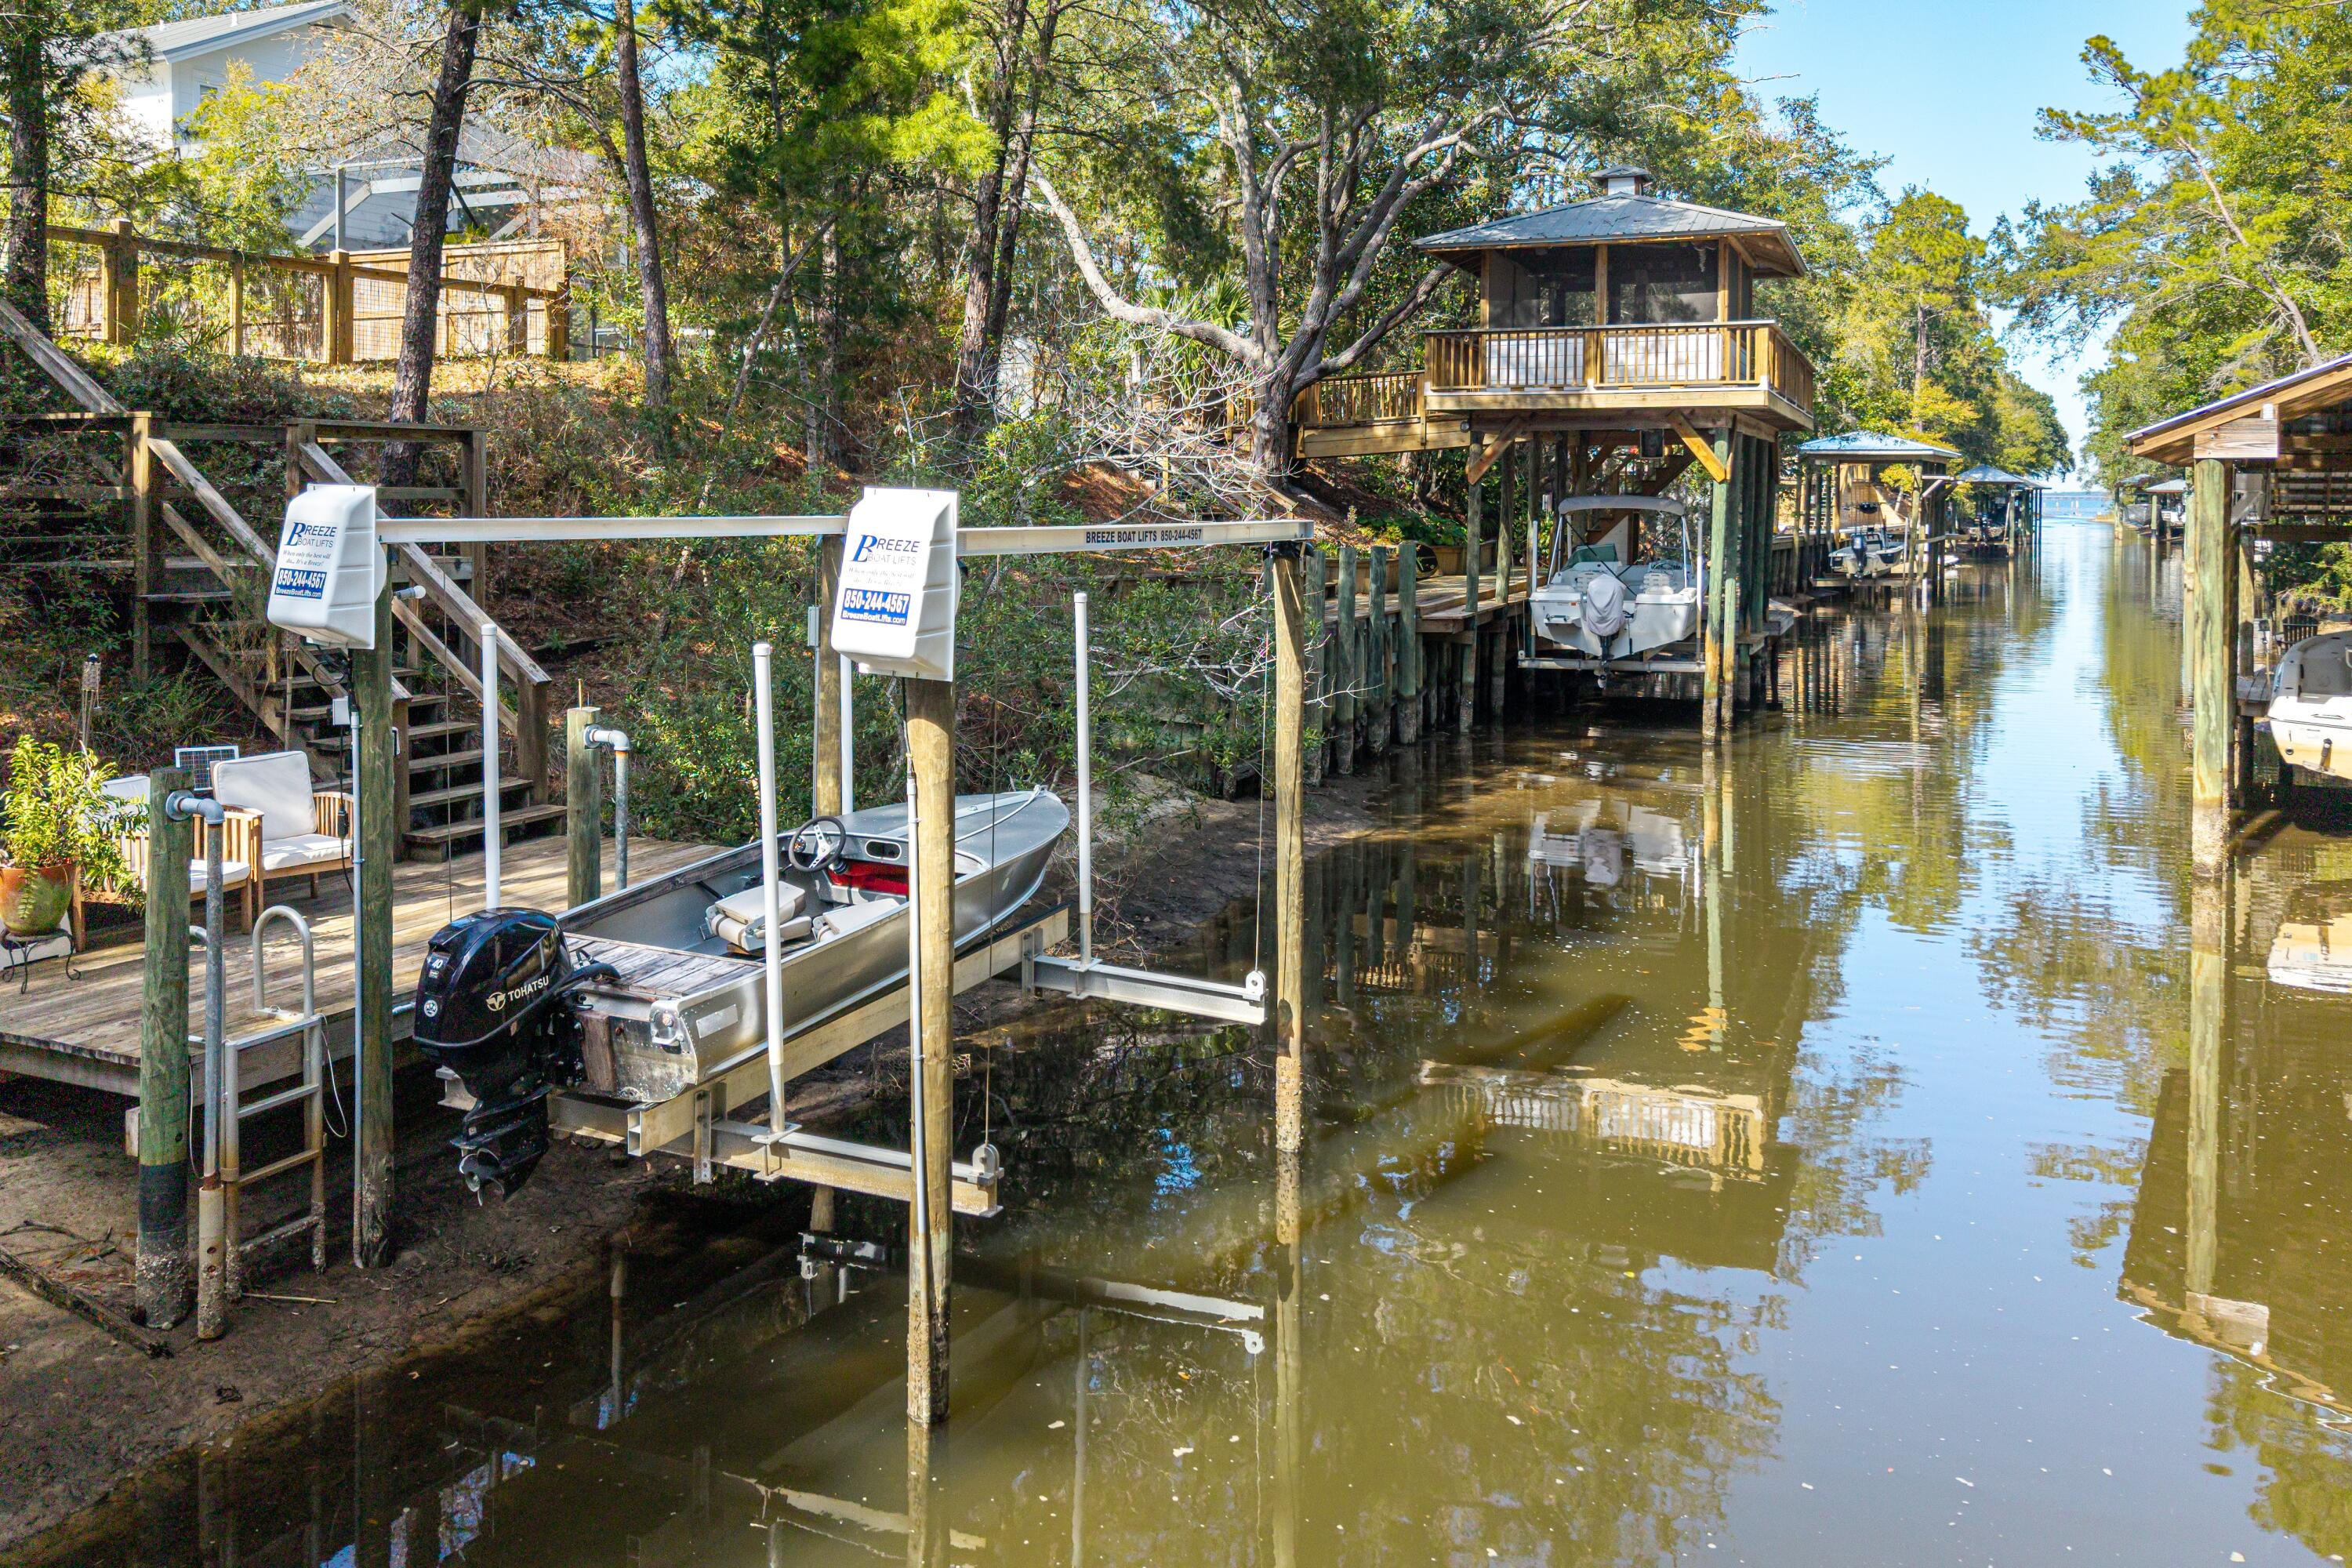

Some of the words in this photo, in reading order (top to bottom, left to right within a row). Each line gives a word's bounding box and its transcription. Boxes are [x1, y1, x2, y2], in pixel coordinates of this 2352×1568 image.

[285, 522, 337, 546] BREEZE
[1086, 531, 1115, 543] BREEZE
[1117, 531, 1136, 543] BOAT
[1138, 530, 1157, 543] LIFTS
[1160, 528, 1202, 542] 850-244-4567
[298, 538, 315, 546] BOAT
[315, 539, 334, 548] LIFTS
[849, 534, 920, 563] BREEZE
[867, 553, 891, 563] BOAT
[892, 554, 917, 566] LIFTS
[278, 569, 325, 589] 850-244-4567
[275, 586, 321, 597] BreezeBoatLifts.com
[844, 590, 909, 613] 850-244-4567
[842, 610, 906, 625] BreezeBoatLifts.com
[507, 975, 549, 1001] TOHATSU
